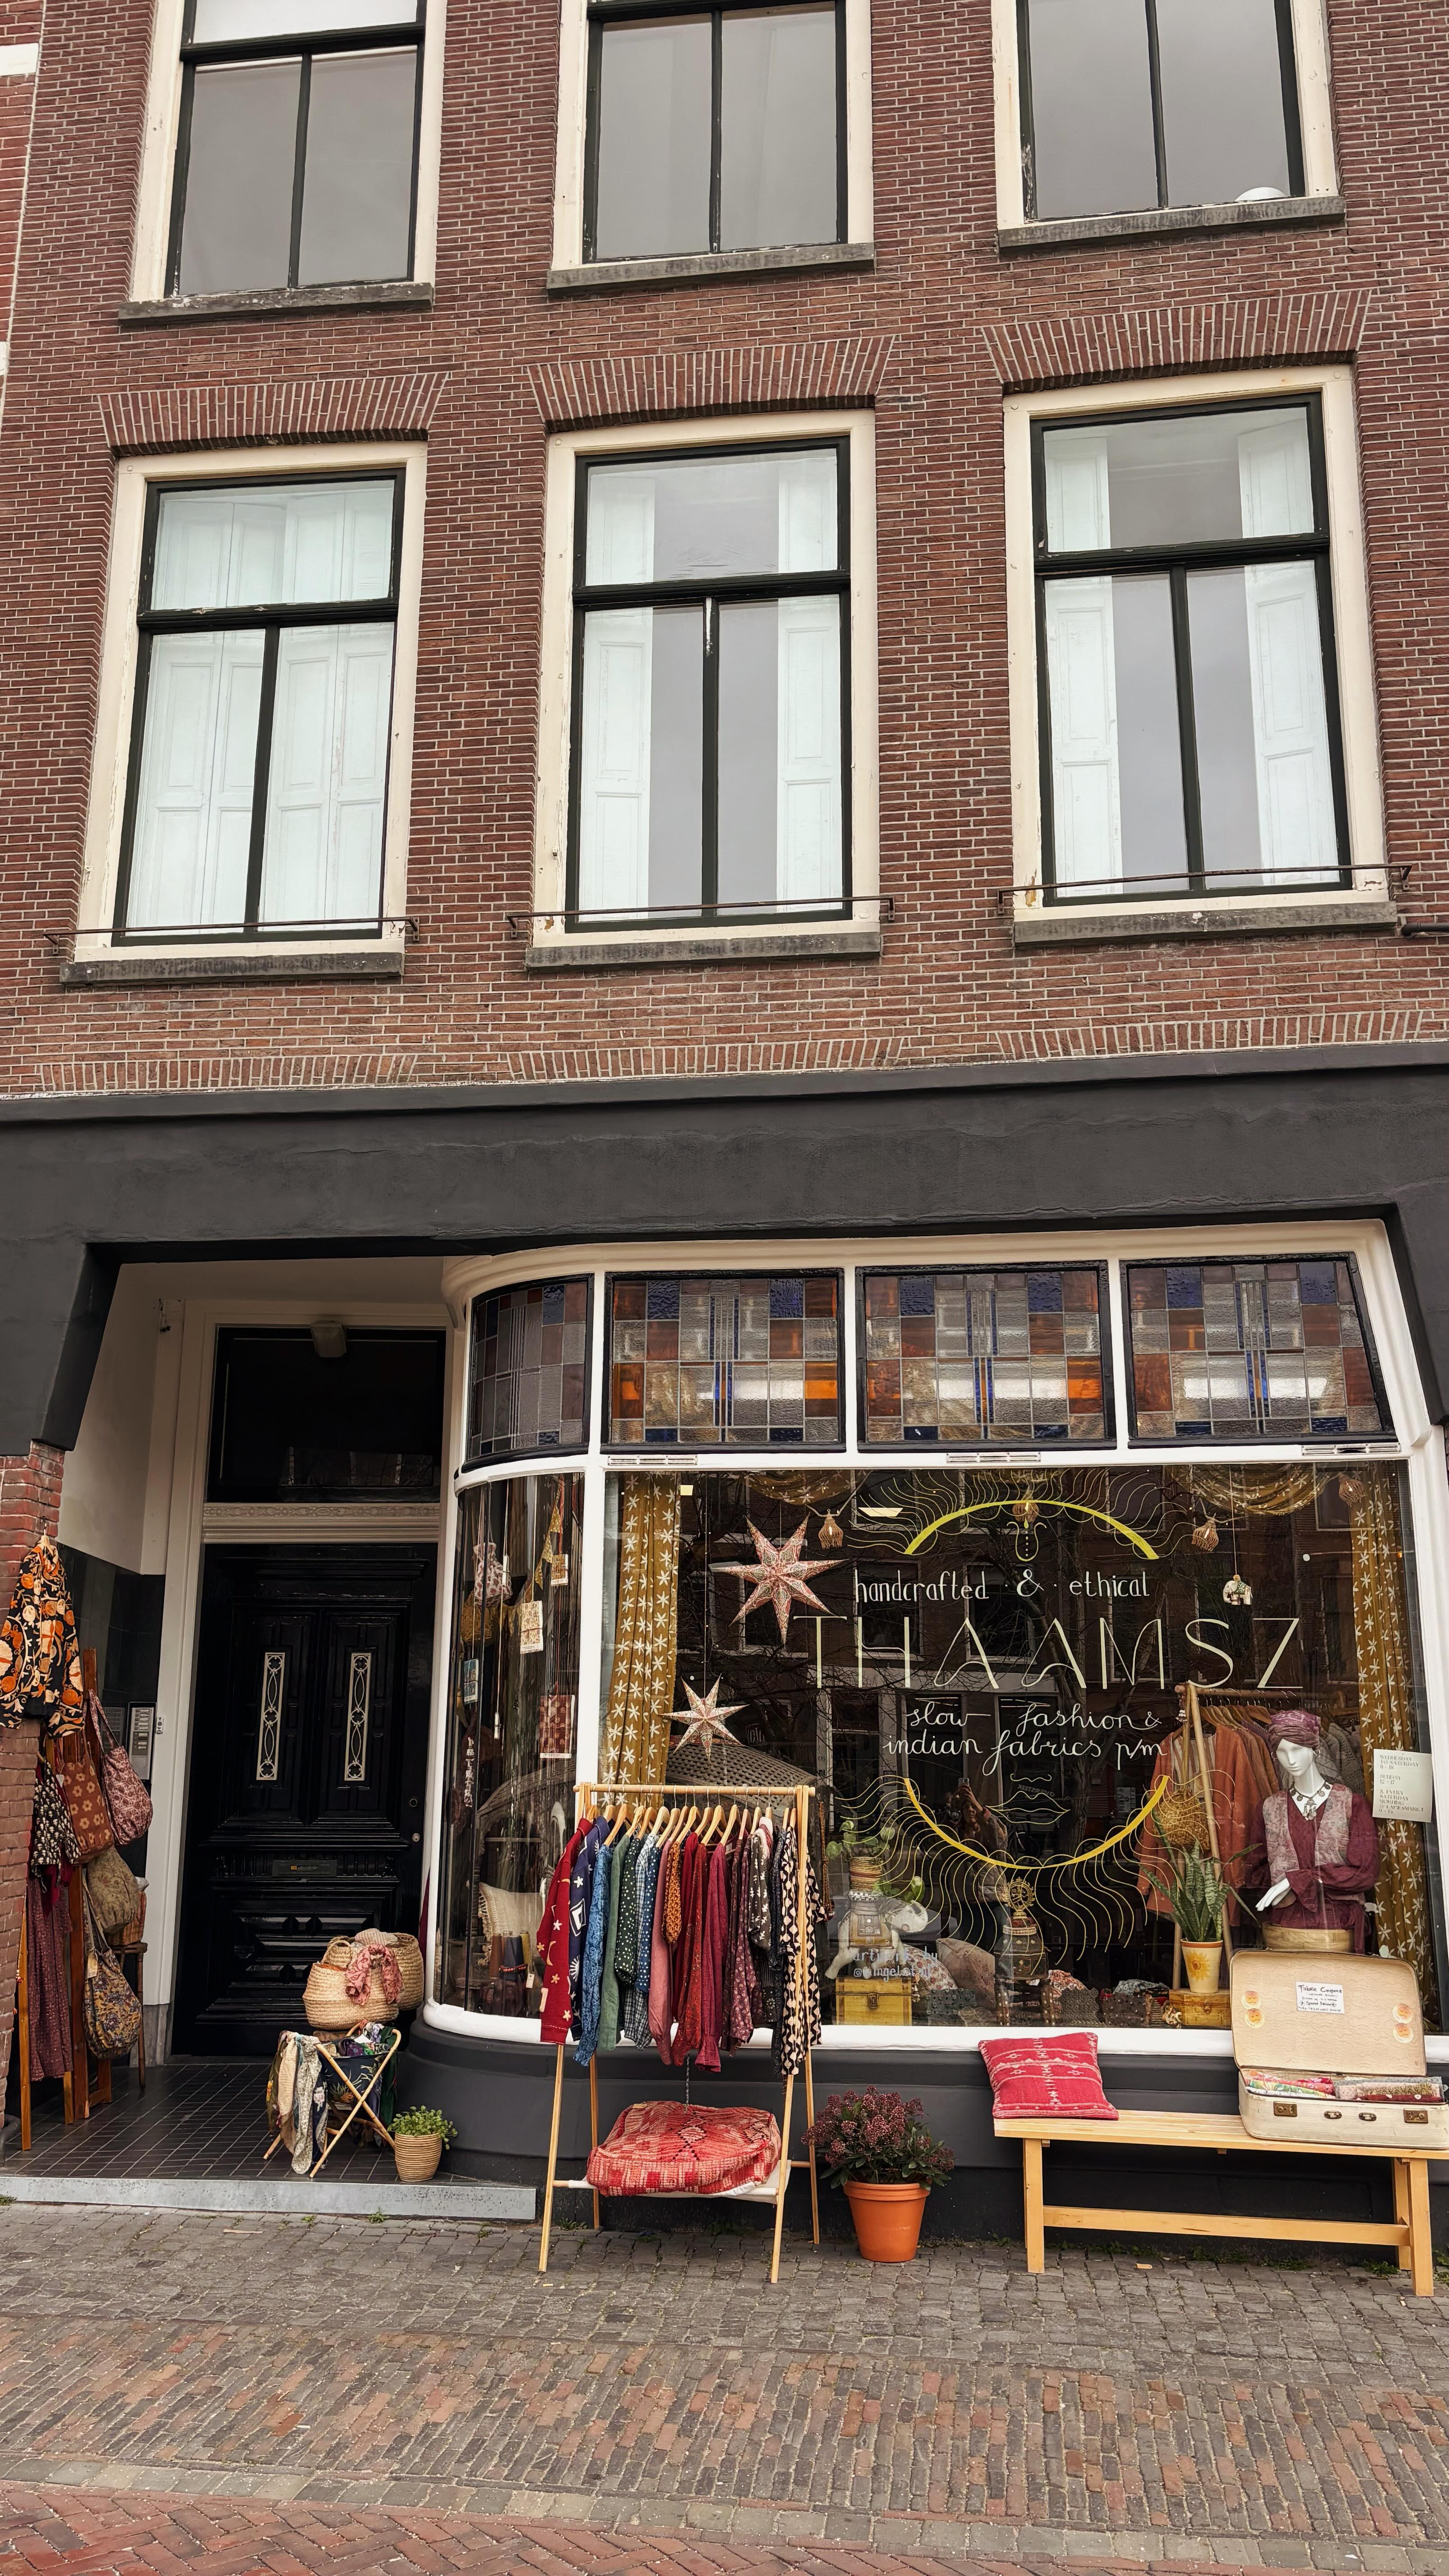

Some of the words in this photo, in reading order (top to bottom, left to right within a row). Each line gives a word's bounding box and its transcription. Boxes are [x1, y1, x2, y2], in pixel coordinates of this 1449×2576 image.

[854, 1569, 989, 1603] handcrafted
[1017, 1569, 1044, 1597] &
[1069, 1571, 1150, 1597] ethical
[793, 1616, 1303, 1689] THAAMSZ
[906, 1701, 991, 1726] slow
[1015, 1703, 1158, 1737] fashion
[1145, 1711, 1162, 1727] &
[882, 1729, 983, 1755] indian
[982, 1730, 1101, 1776] fabrics
